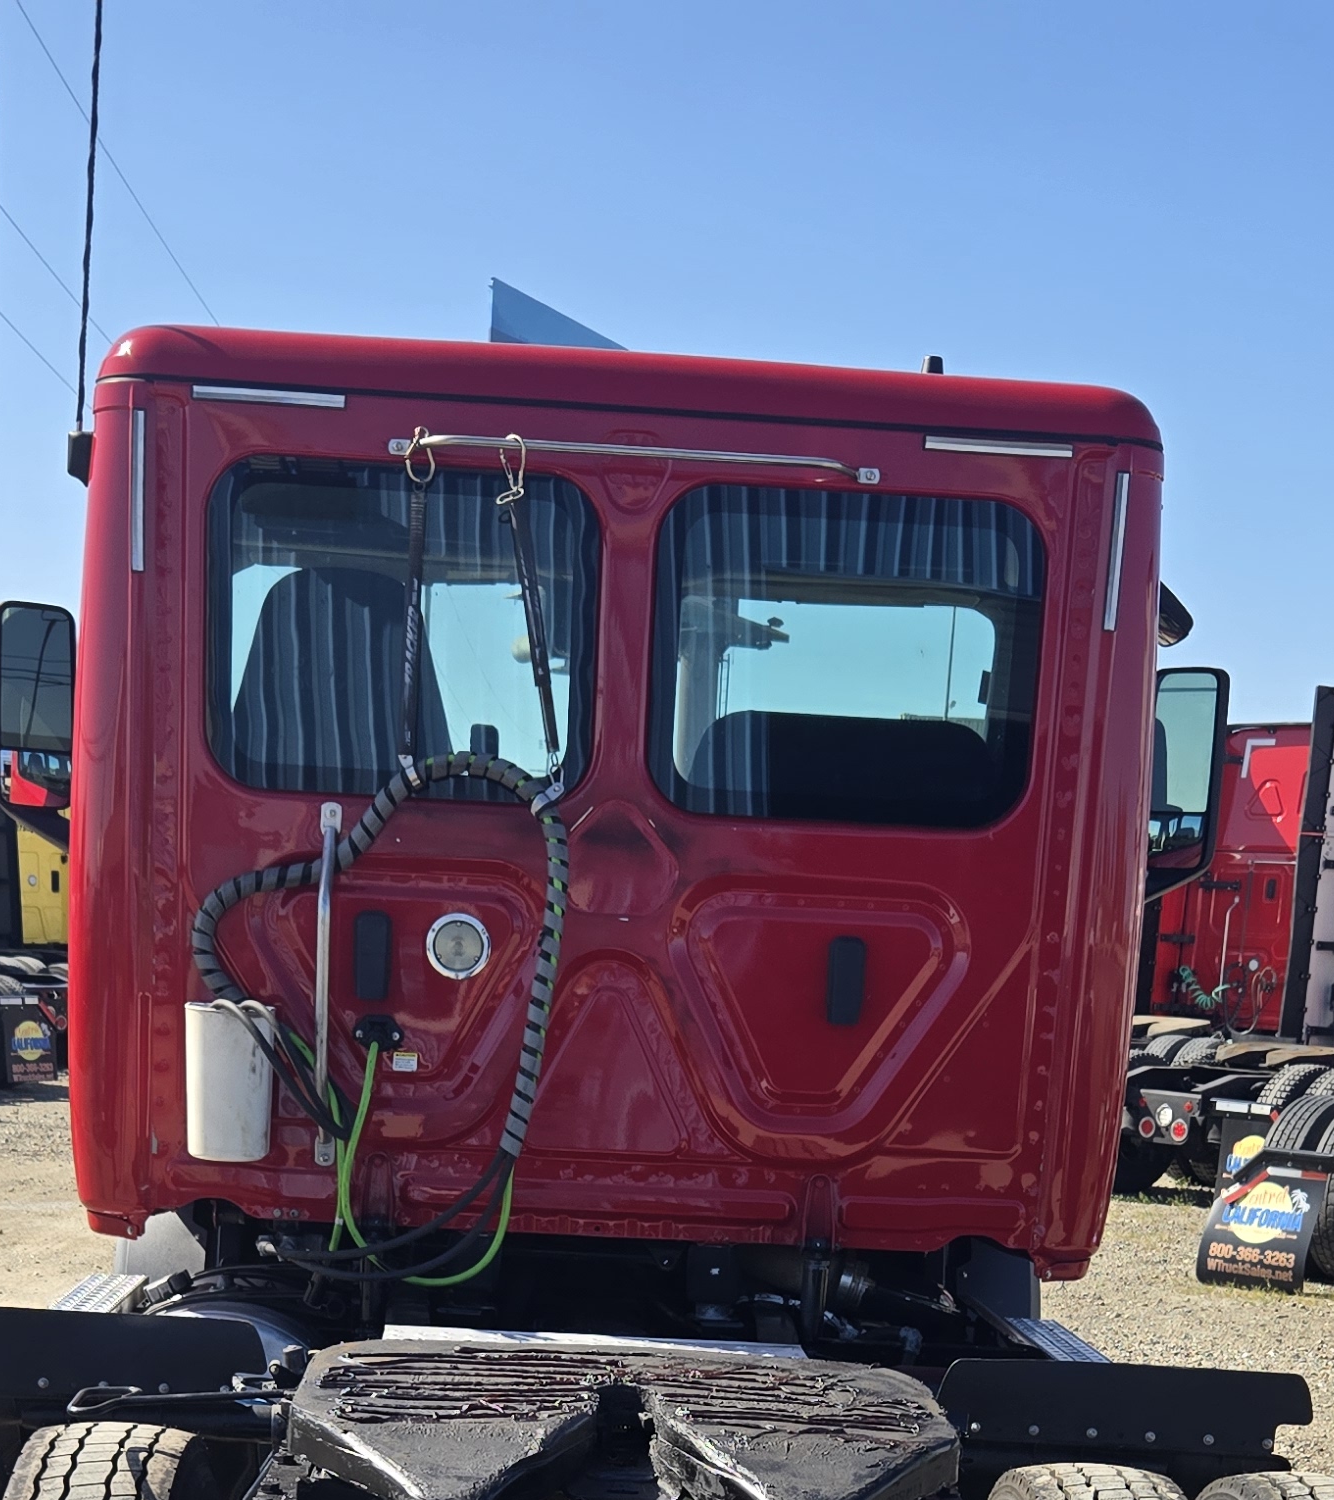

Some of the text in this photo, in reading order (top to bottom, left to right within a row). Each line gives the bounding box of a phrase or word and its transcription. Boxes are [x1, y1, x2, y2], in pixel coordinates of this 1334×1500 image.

[1222, 1203, 1305, 1232] CALIFORNIA
[1209, 1242, 1295, 1268] 800-366-3263
[1207, 1257, 1293, 1282] WTruckSales.net
